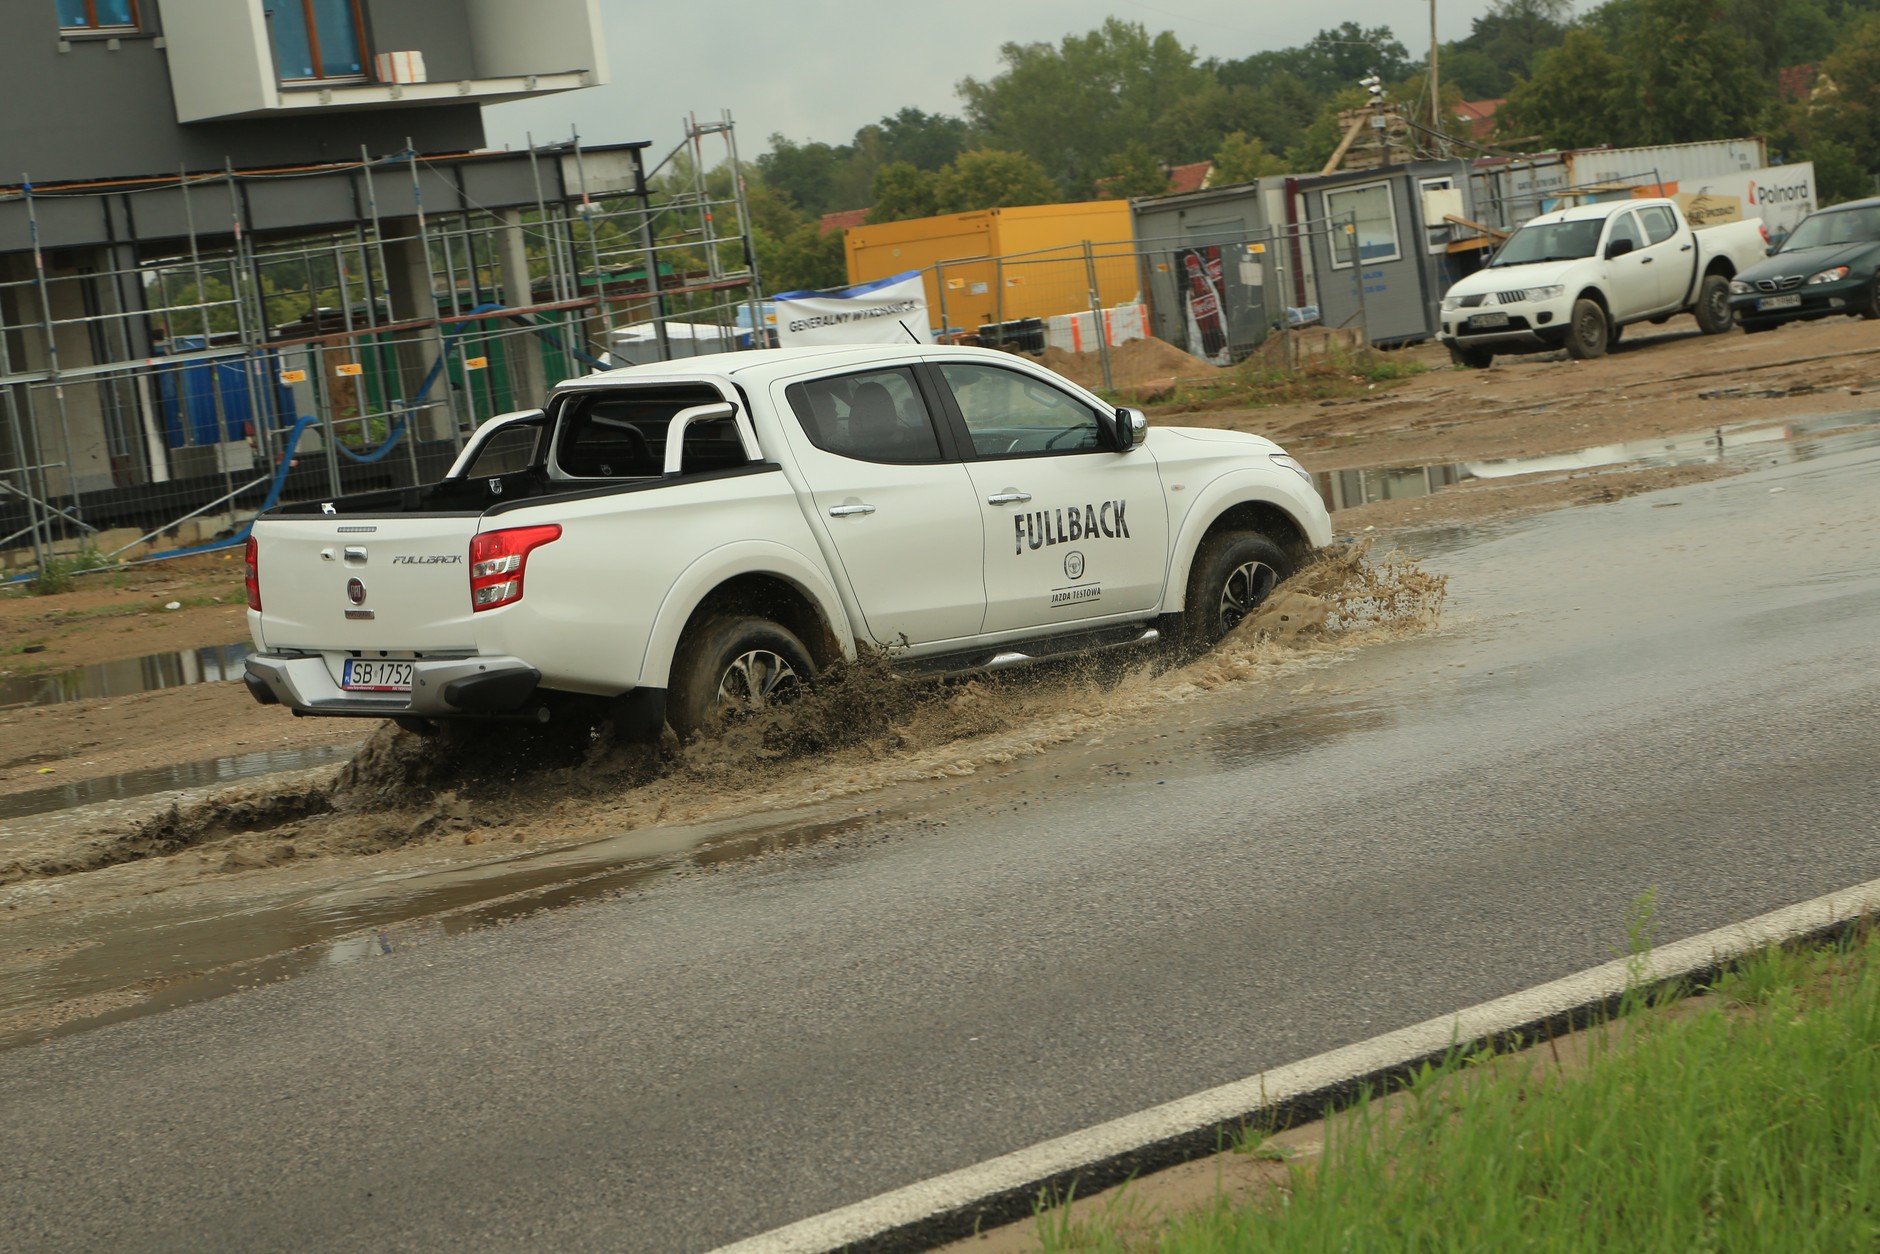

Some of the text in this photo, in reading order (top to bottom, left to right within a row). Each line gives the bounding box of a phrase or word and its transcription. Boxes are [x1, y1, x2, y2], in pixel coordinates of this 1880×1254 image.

[1757, 180, 1808, 205] Polnord
[789, 300, 917, 332] GENERALNY WYKONAWCA
[1014, 499, 1131, 556] FULLBACK
[392, 555, 463, 565] FULLBACK
[350, 584, 361, 598] FIAT
[1051, 587, 1101, 603] JAZDA TESTOWA
[352, 663, 412, 685] SB 1752
